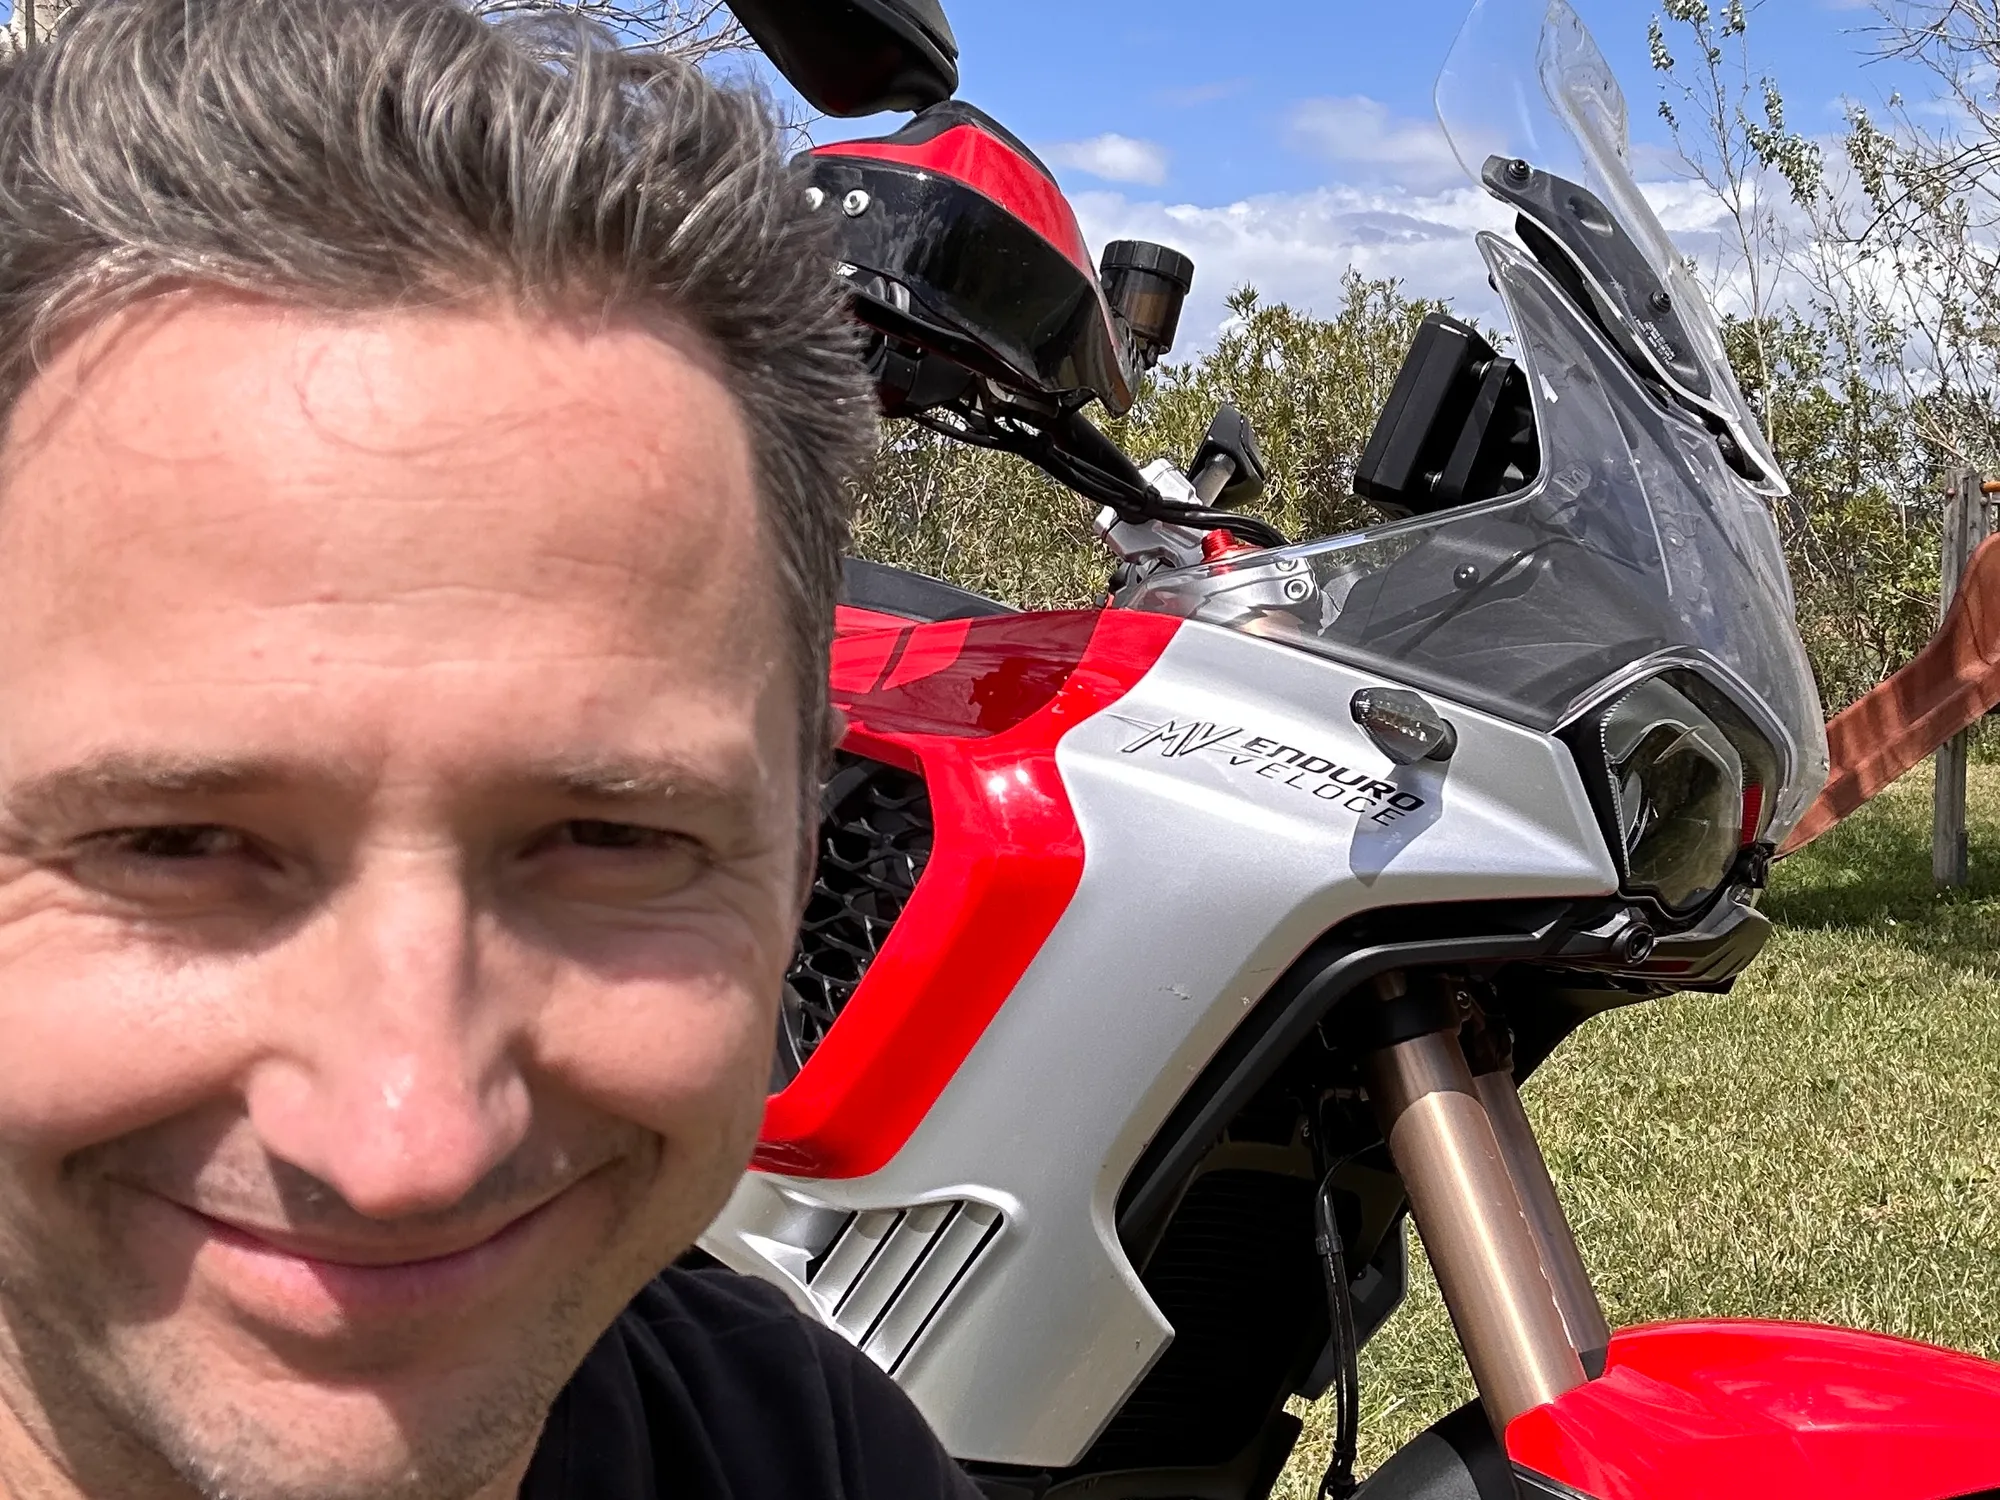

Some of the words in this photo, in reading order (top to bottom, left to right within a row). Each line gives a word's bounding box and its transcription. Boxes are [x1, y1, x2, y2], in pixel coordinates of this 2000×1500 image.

[1121, 719, 1245, 758] MV
[1240, 736, 1426, 812] ENDURO
[1230, 755, 1407, 827] VELOCE
